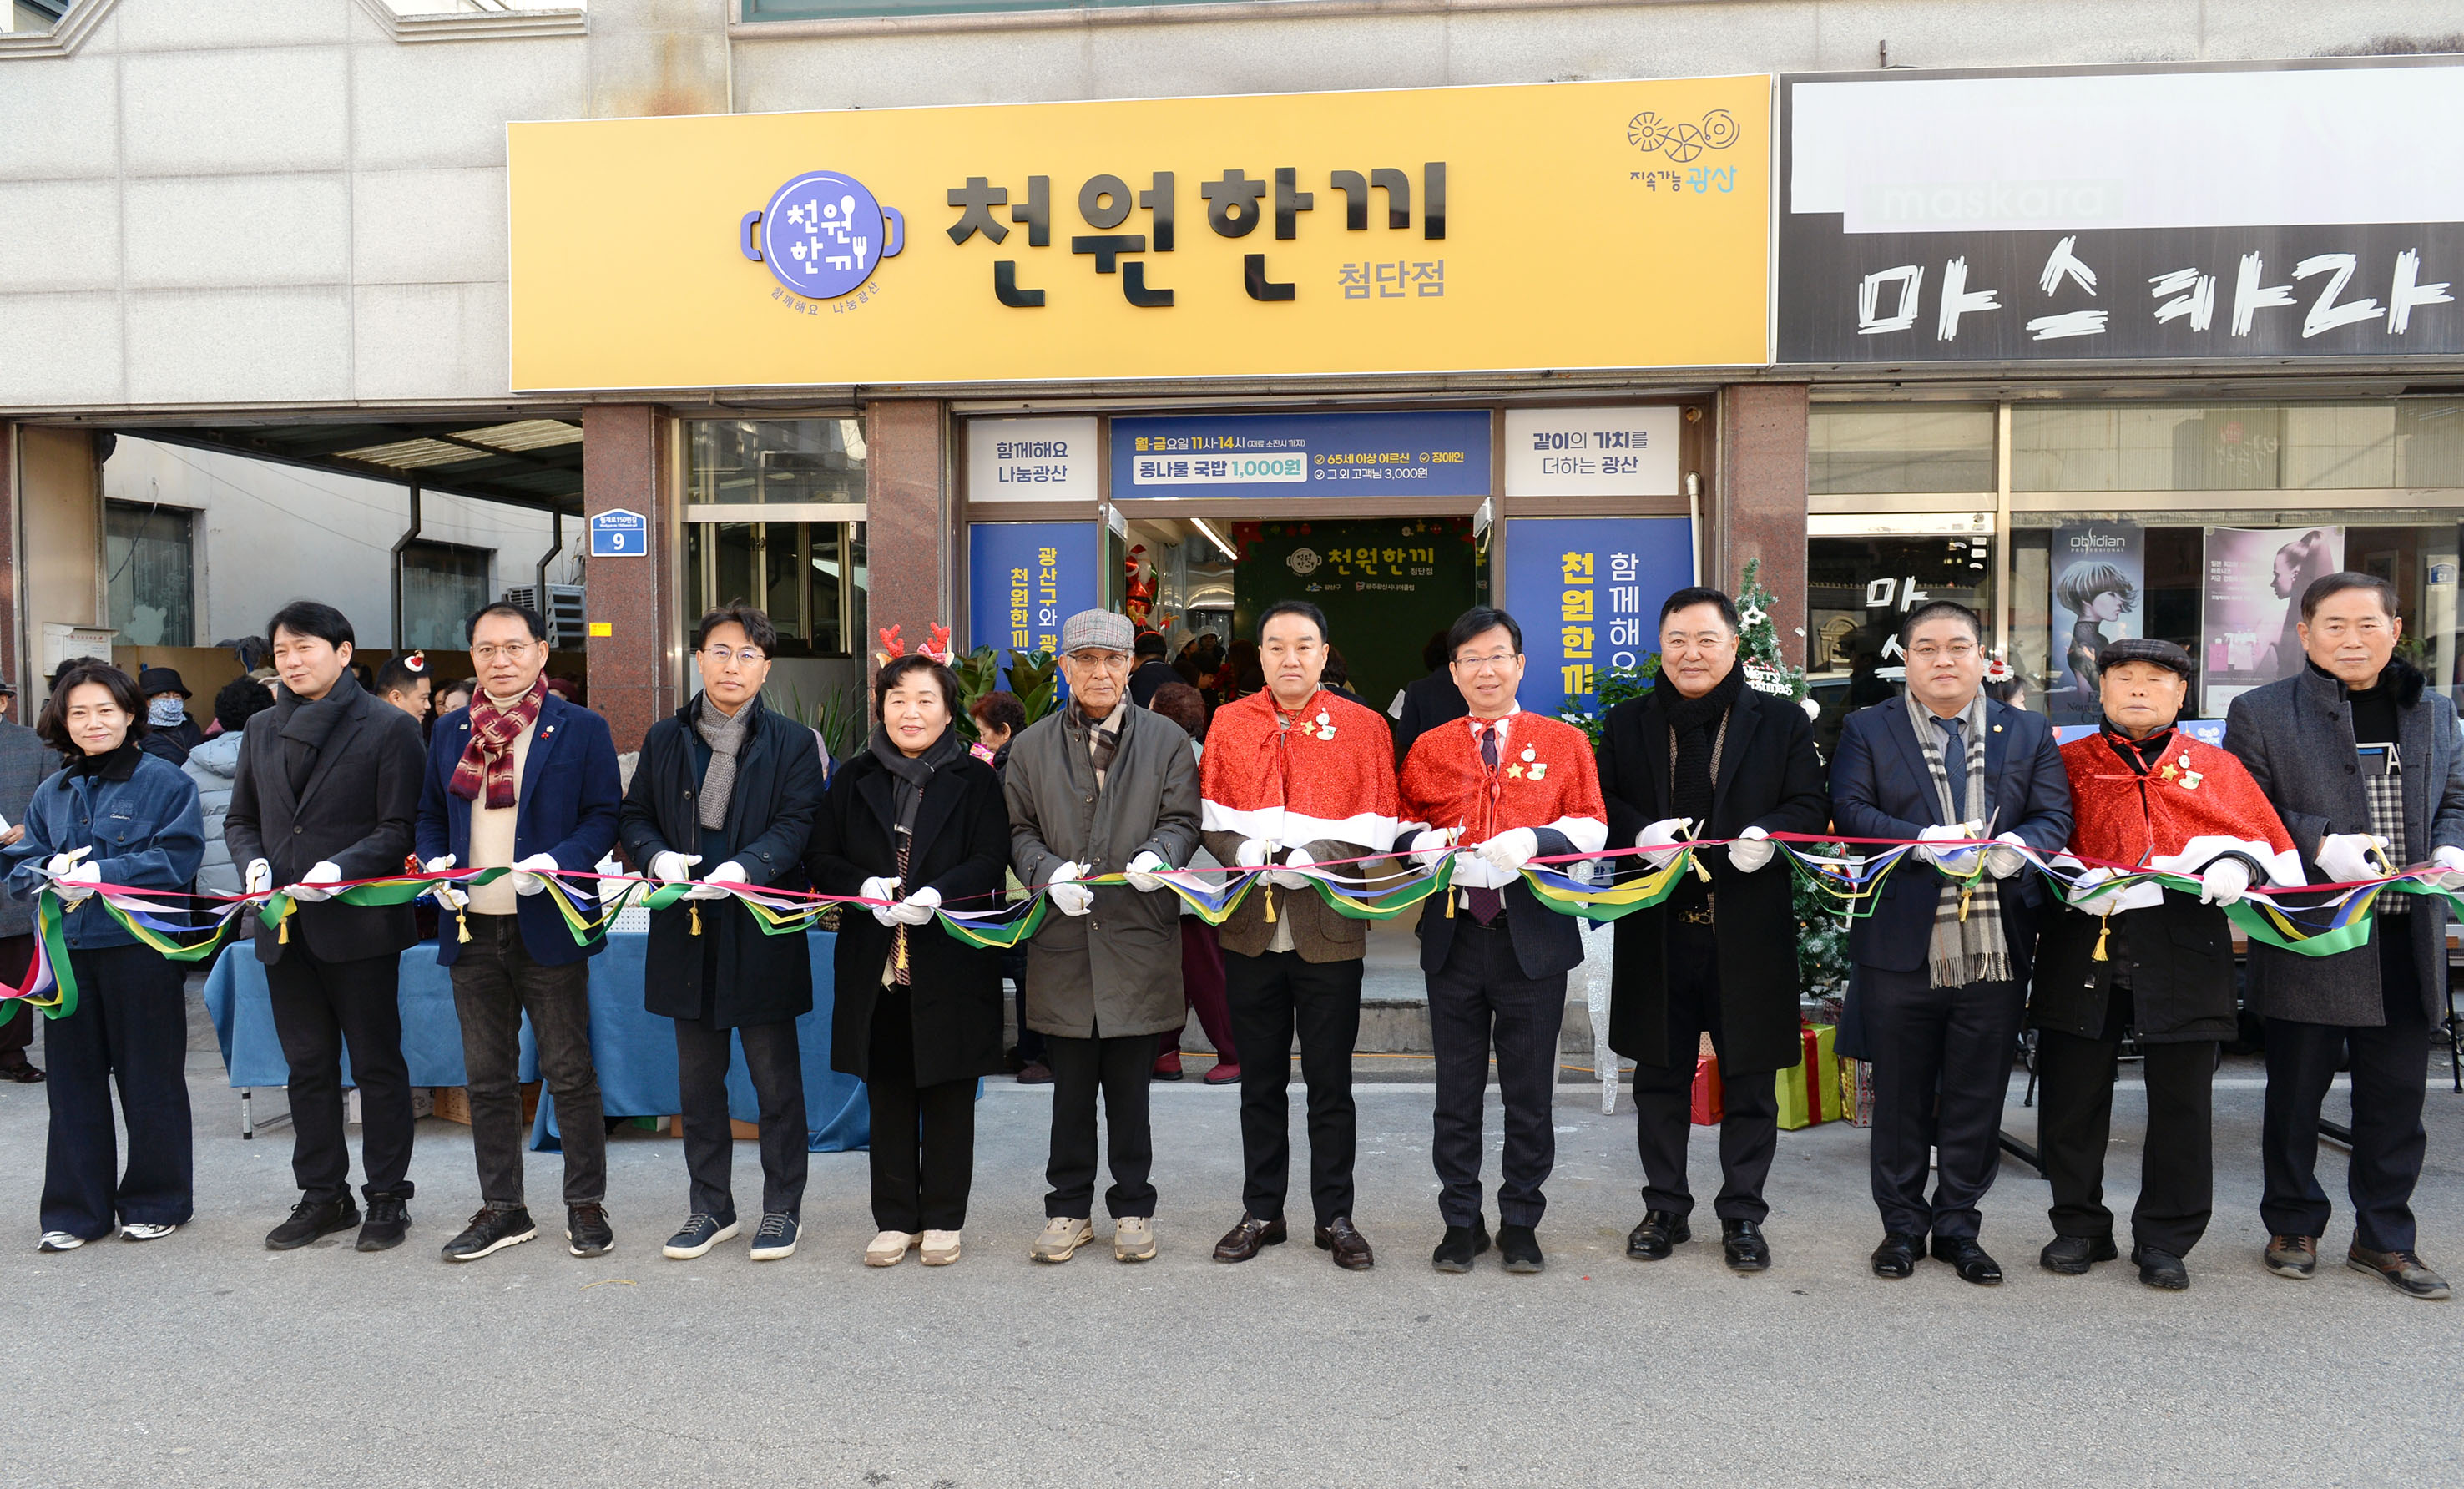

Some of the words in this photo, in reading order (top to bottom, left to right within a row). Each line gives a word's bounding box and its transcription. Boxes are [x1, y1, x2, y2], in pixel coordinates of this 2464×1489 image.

[1629, 170, 1681, 192] 지속가능
[1685, 165, 1738, 194] 광산
[787, 194, 856, 244] 천원
[945, 161, 1447, 308] 천원한끼
[790, 236, 868, 275] 한끼
[1337, 259, 1446, 300] 첨단점
[1857, 235, 2456, 341] 마스카라
[770, 286, 819, 315] 함께해요
[832, 281, 880, 314] 나눔광산
[997, 441, 1068, 459] 함께해요
[1134, 437, 1189, 452] 월-금요일
[1191, 436, 1245, 450] 11시-14시
[1288, 438, 1306, 448] 까지)
[1532, 432, 1588, 450] 같이의
[1593, 431, 1648, 449] 가치를
[1139, 461, 1189, 478] 콩나물
[1194, 460, 1227, 477] 국밥
[1231, 459, 1301, 478] 1,000원
[1326, 453, 1354, 465] 65세
[1356, 453, 1377, 464] 이상
[1378, 452, 1410, 464] 어르신
[1431, 452, 1465, 463] 장애인
[1543, 457, 1596, 475] 더하는
[1601, 457, 1638, 474] 광산
[999, 465, 1068, 482] 나눔광산
[1327, 469, 1337, 480] 그
[1339, 468, 1350, 480] 외
[1351, 467, 1382, 480] 고객님
[1384, 467, 1428, 481] 3,000원
[613, 533, 625, 551] 9
[2070, 527, 2125, 548] obsidian
[1328, 547, 1434, 575] 천원한끼
[1038, 547, 1058, 627] 광산구와
[1010, 568, 1029, 655] 천원한끼
[1561, 551, 1595, 694] 천원한끼
[1609, 552, 1640, 678] 함께해요
